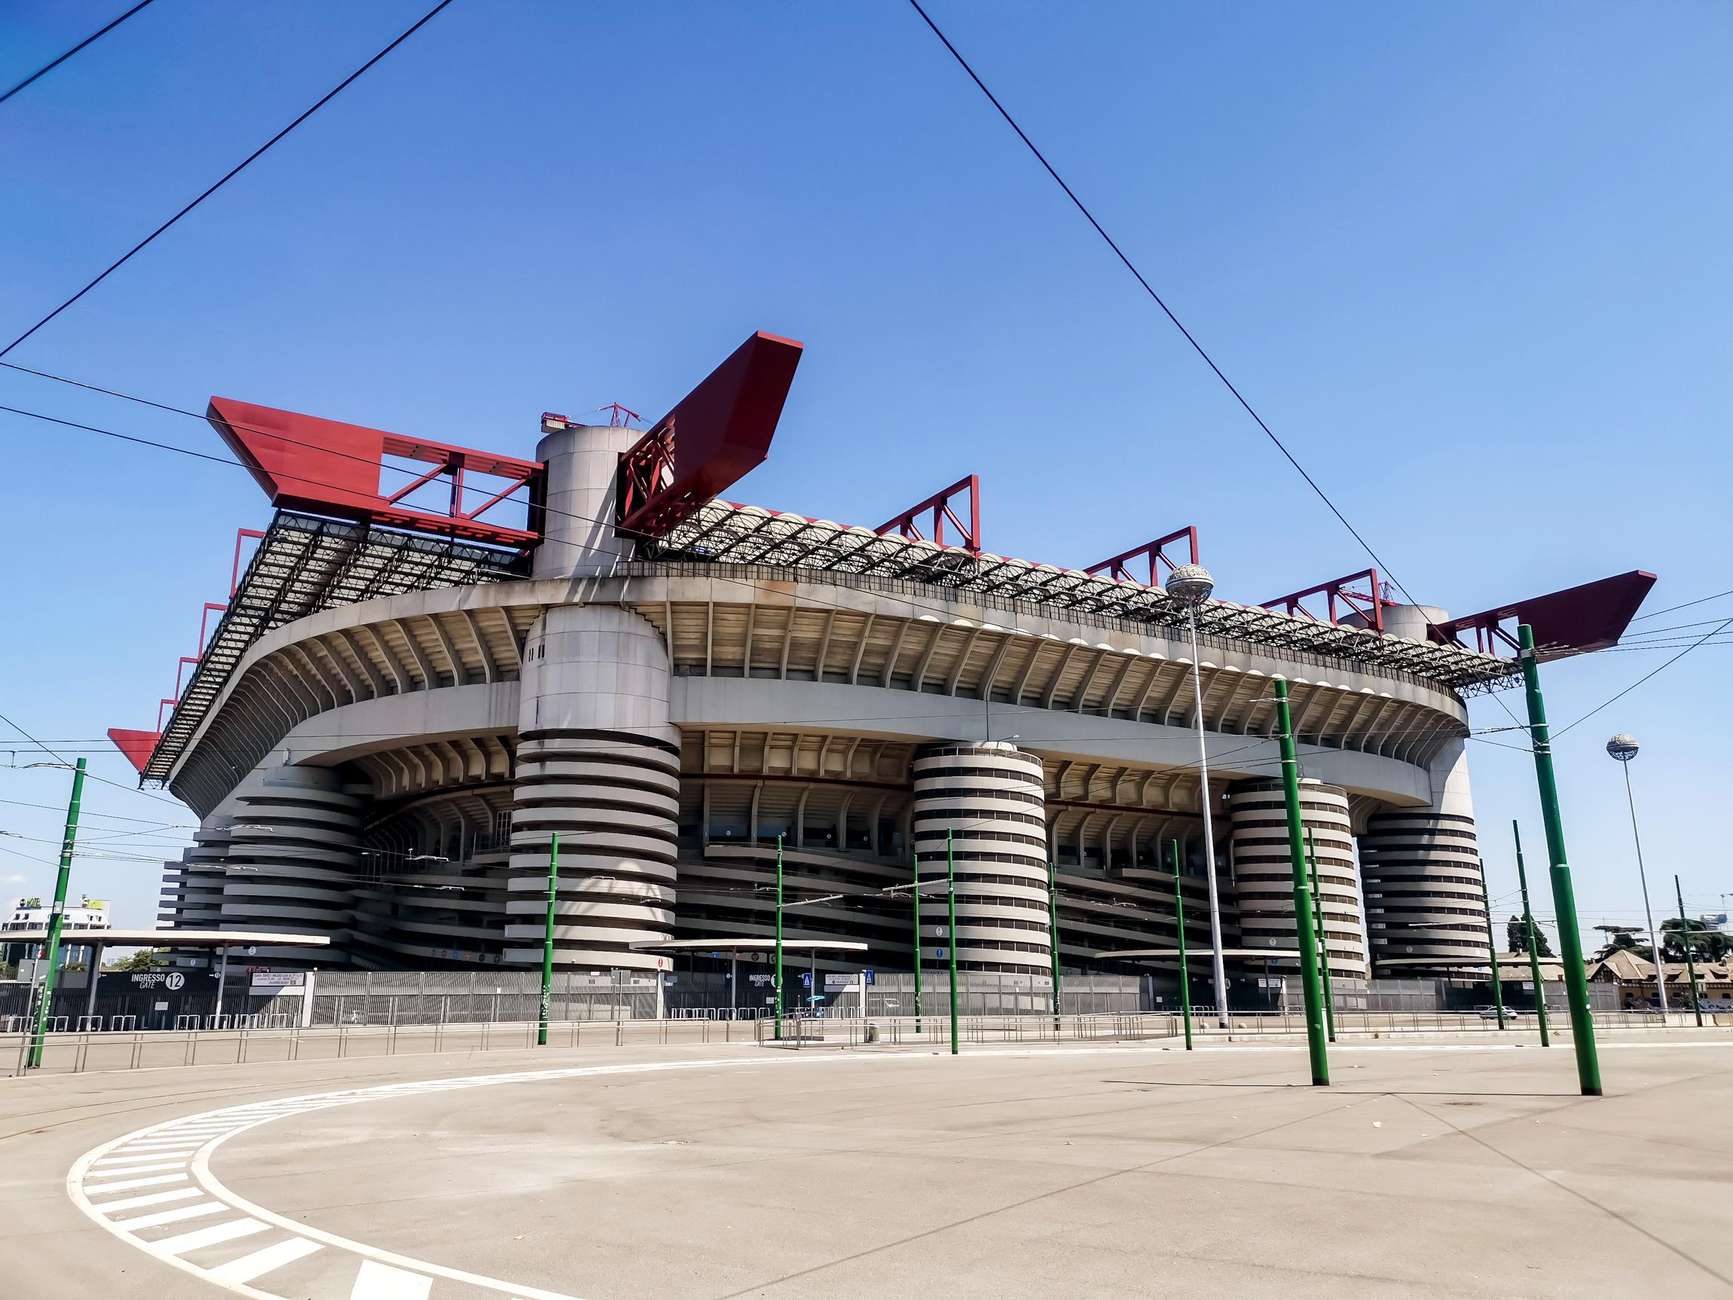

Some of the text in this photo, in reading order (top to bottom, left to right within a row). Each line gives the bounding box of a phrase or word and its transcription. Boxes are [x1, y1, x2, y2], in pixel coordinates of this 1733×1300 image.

[131, 973, 165, 982] INGRESSO
[169, 974, 182, 988] 12
[139, 981, 155, 989] GATE
